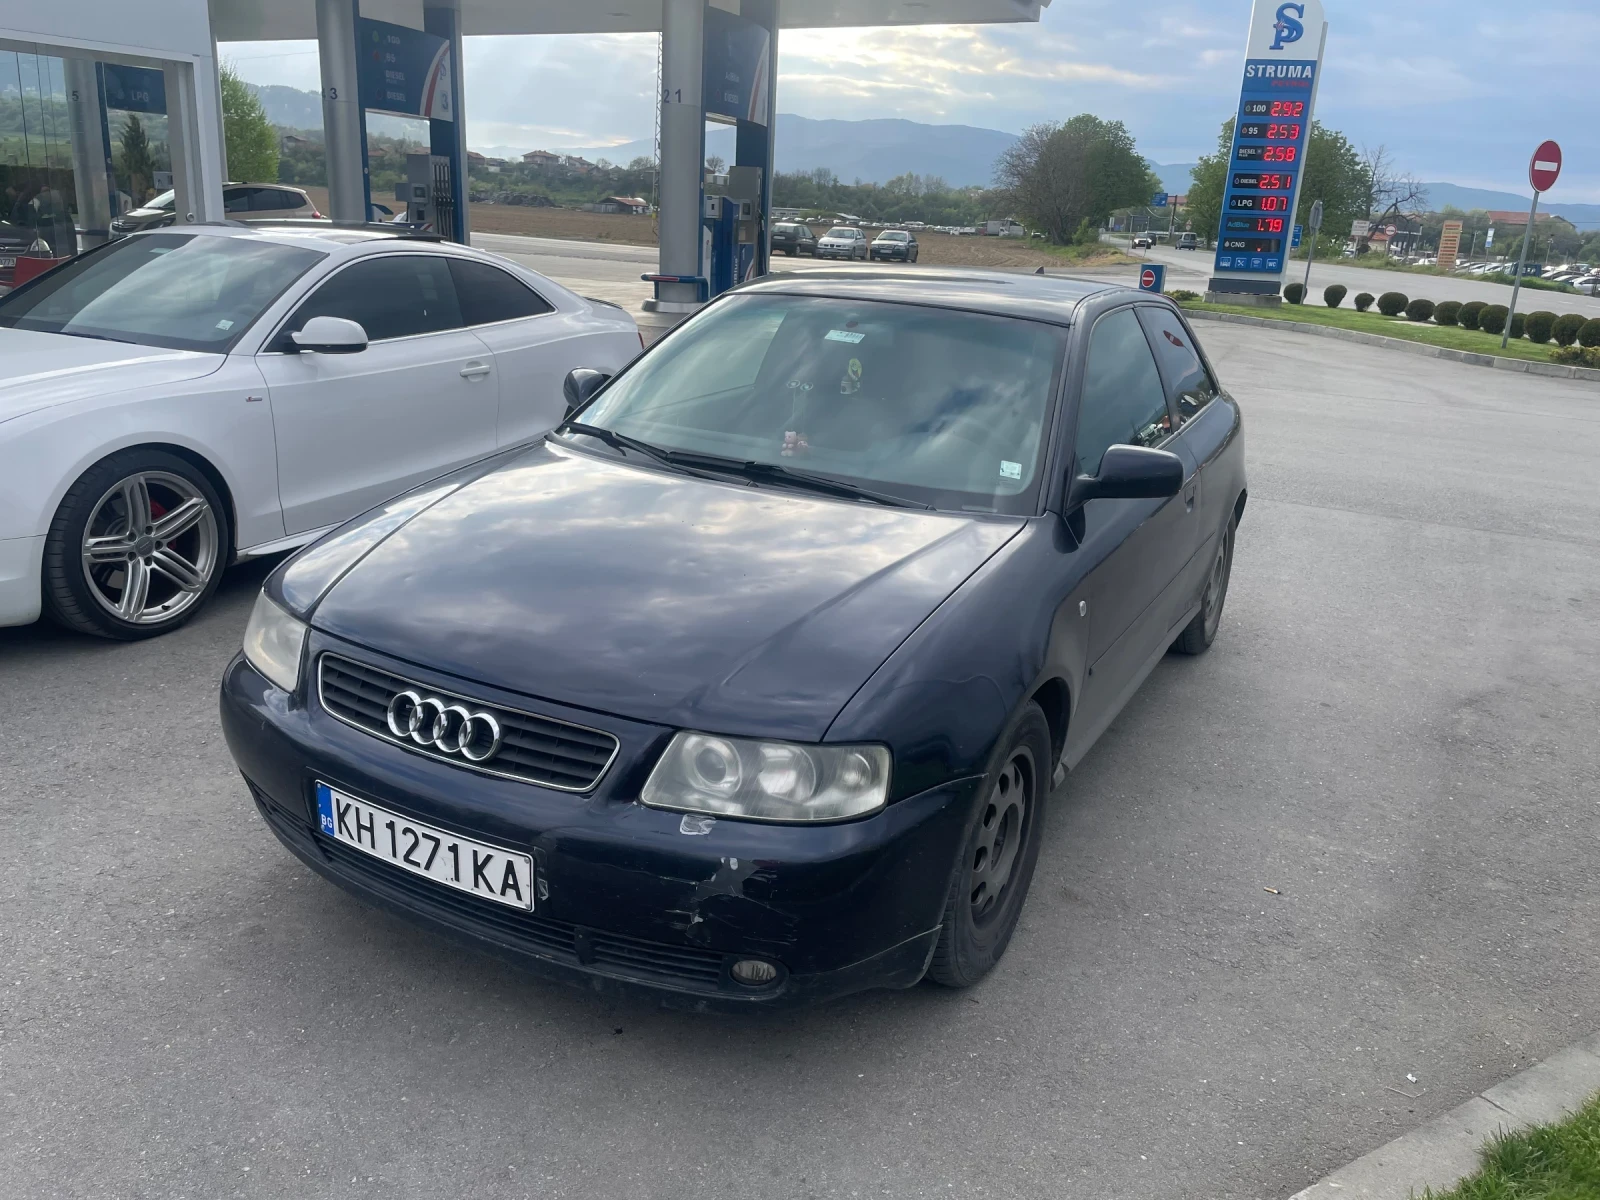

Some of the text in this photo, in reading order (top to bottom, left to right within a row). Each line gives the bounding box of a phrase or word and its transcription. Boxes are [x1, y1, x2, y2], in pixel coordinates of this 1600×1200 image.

[385, 70, 405, 81] DIESEL
[1246, 64, 1312, 78] STRUMA
[71, 91, 79, 101] 5
[131, 91, 149, 102] LPG
[330, 87, 338, 100] 3
[663, 88, 681, 104] 2 1
[1252, 101, 1304, 117] 100 2.92
[1248, 124, 1300, 139] 95 2.53
[1263, 146, 1296, 161] 2.58
[1259, 175, 1291, 189] 2.51
[1237, 197, 1287, 211] LPG 1.07
[1257, 219, 1283, 232] 1.79
[321, 814, 333, 828] BG
[335, 797, 523, 902] KH 1271 KA
